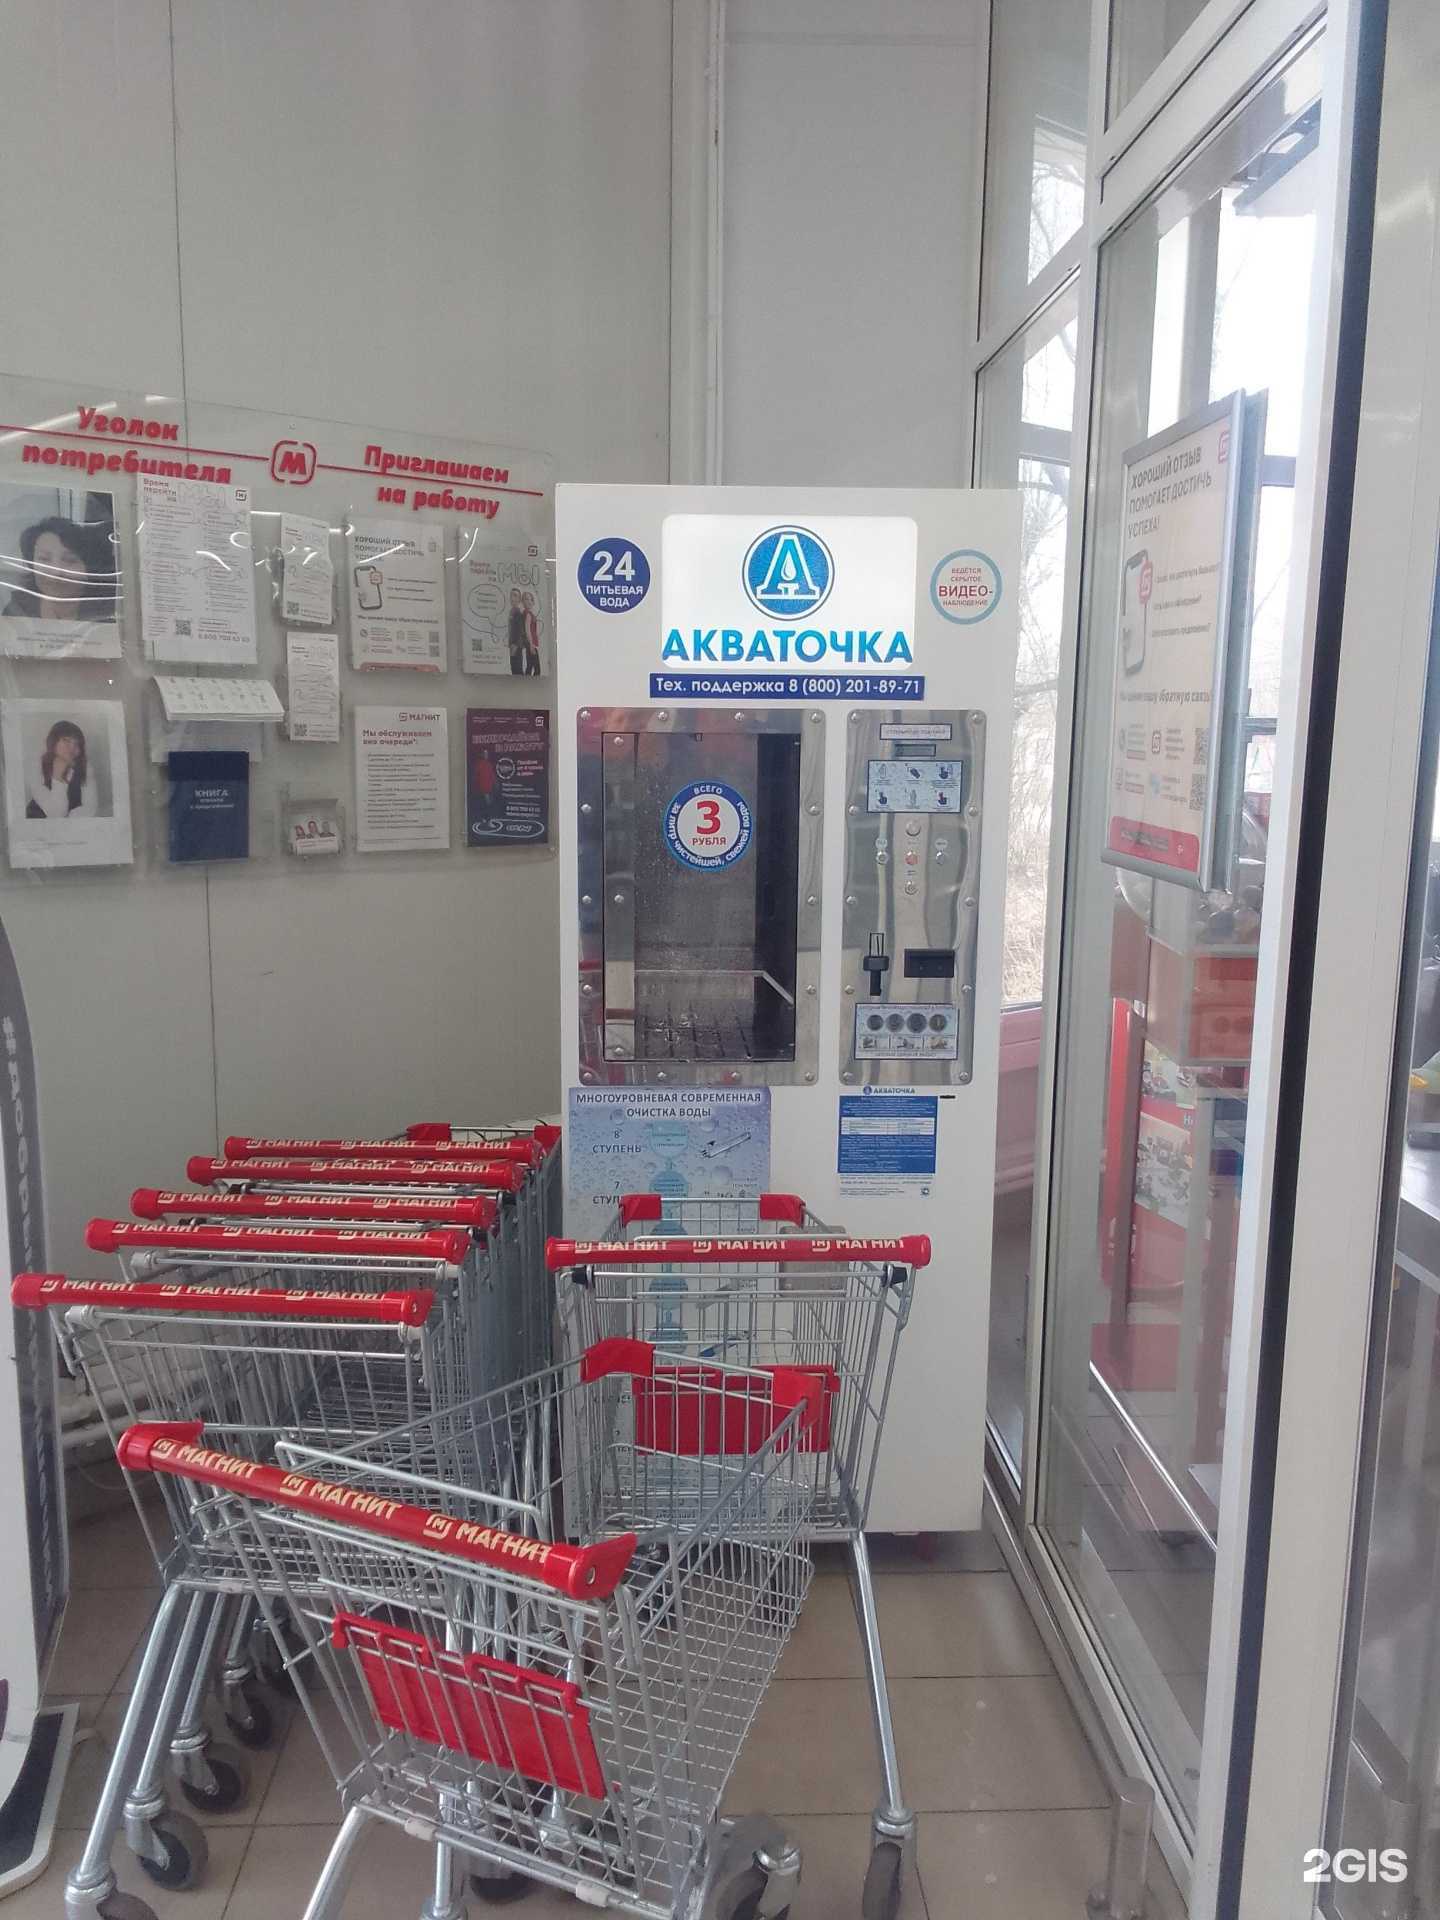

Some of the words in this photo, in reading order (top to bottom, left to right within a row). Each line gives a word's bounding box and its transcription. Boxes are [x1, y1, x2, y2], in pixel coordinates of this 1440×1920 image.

[78, 406, 180, 441] Уголок
[22, 445, 232, 484] потребителя
[364, 444, 509, 484] Приглашаем
[1132, 455, 1172, 490] ХОРОШИЙ
[1174, 446, 1202, 474] ОТЗЫВ
[377, 486, 406, 505] на
[412, 489, 500, 519] работу
[1129, 486, 1171, 513] ПОМОГАЕТ
[594, 550, 636, 581] 24
[586, 585, 643, 595] ПИТЬЕВАЯ
[938, 585, 993, 598] ВИДЕО-
[600, 597, 630, 608] ВОДА
[661, 628, 915, 664] АКВАТОЧКА
[656, 677, 687, 692] Тех.
[692, 680, 785, 694] поддержка
[789, 680, 798, 692] 8
[803, 680, 841, 695] (800)
[846, 680, 920, 694] 201-89-71
[409, 713, 441, 721] МАГНИТ
[694, 785, 723, 794] ВСЕГО
[696, 800, 721, 835] 3
[692, 837, 727, 846] РУБЛЯ
[576, 1093, 678, 1103] МНОГОУРОВНЕВАЯ
[681, 1093, 761, 1103] СОВРЕМЕННАЯ
[626, 1107, 677, 1117] ОЧИСТКА
[679, 1107, 711, 1118] ВОДЫ
[592, 1144, 642, 1153] СТУПЕНЬ
[614, 1181, 621, 1189] 7
[176, 1444, 263, 1479] МАГНИТ
[309, 1481, 402, 1520] МАГНИТ
[455, 1522, 552, 1564] МАГНИТ
